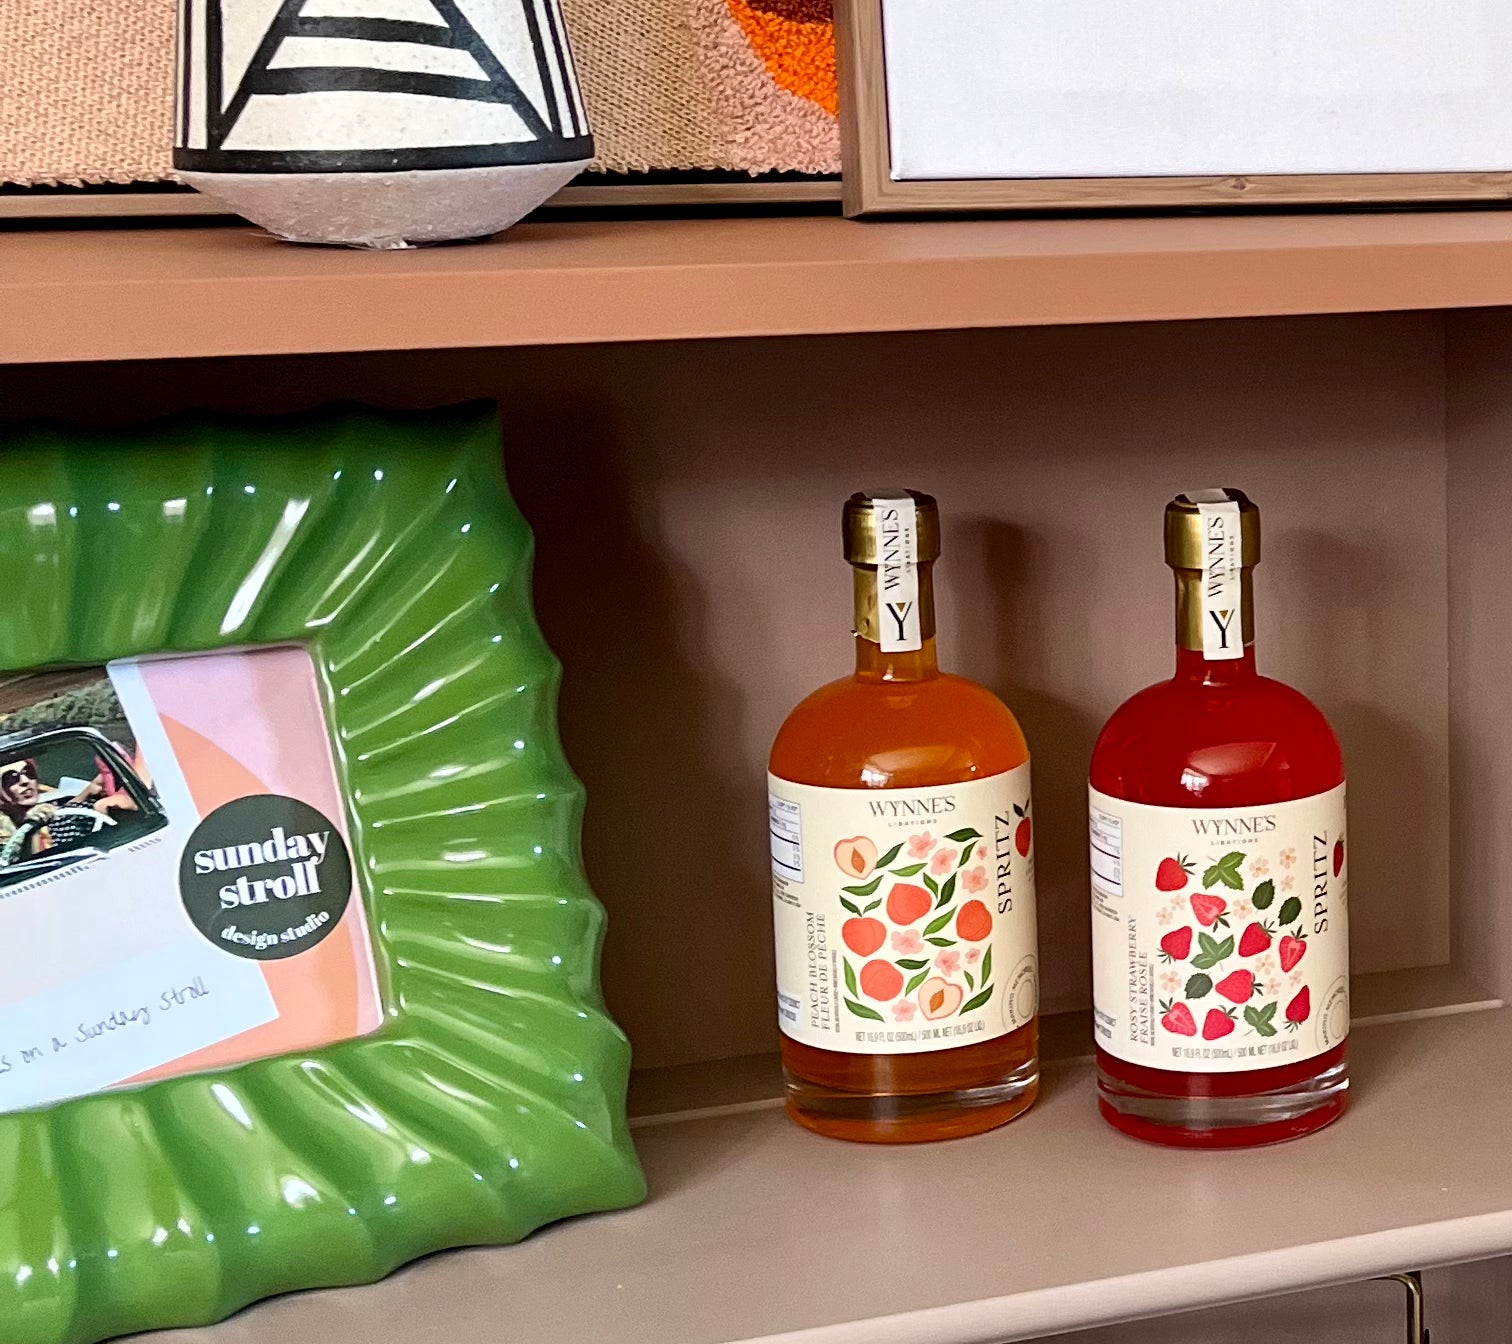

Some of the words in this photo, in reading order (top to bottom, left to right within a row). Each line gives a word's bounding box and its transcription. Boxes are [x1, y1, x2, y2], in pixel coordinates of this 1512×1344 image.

[886, 601, 912, 641] Y
[1209, 609, 1235, 649] Y
[194, 827, 331, 874] sunday
[994, 810, 1013, 915] SPRITZ
[219, 856, 322, 909] stroll
[1313, 830, 1329, 935] SPRITZ
[221, 925, 279, 950] design
[279, 911, 330, 943] studio
[806, 911, 817, 977] BLOSSOM
[52, 1037, 67, 1052] a
[76, 1006, 150, 1043] Sunday
